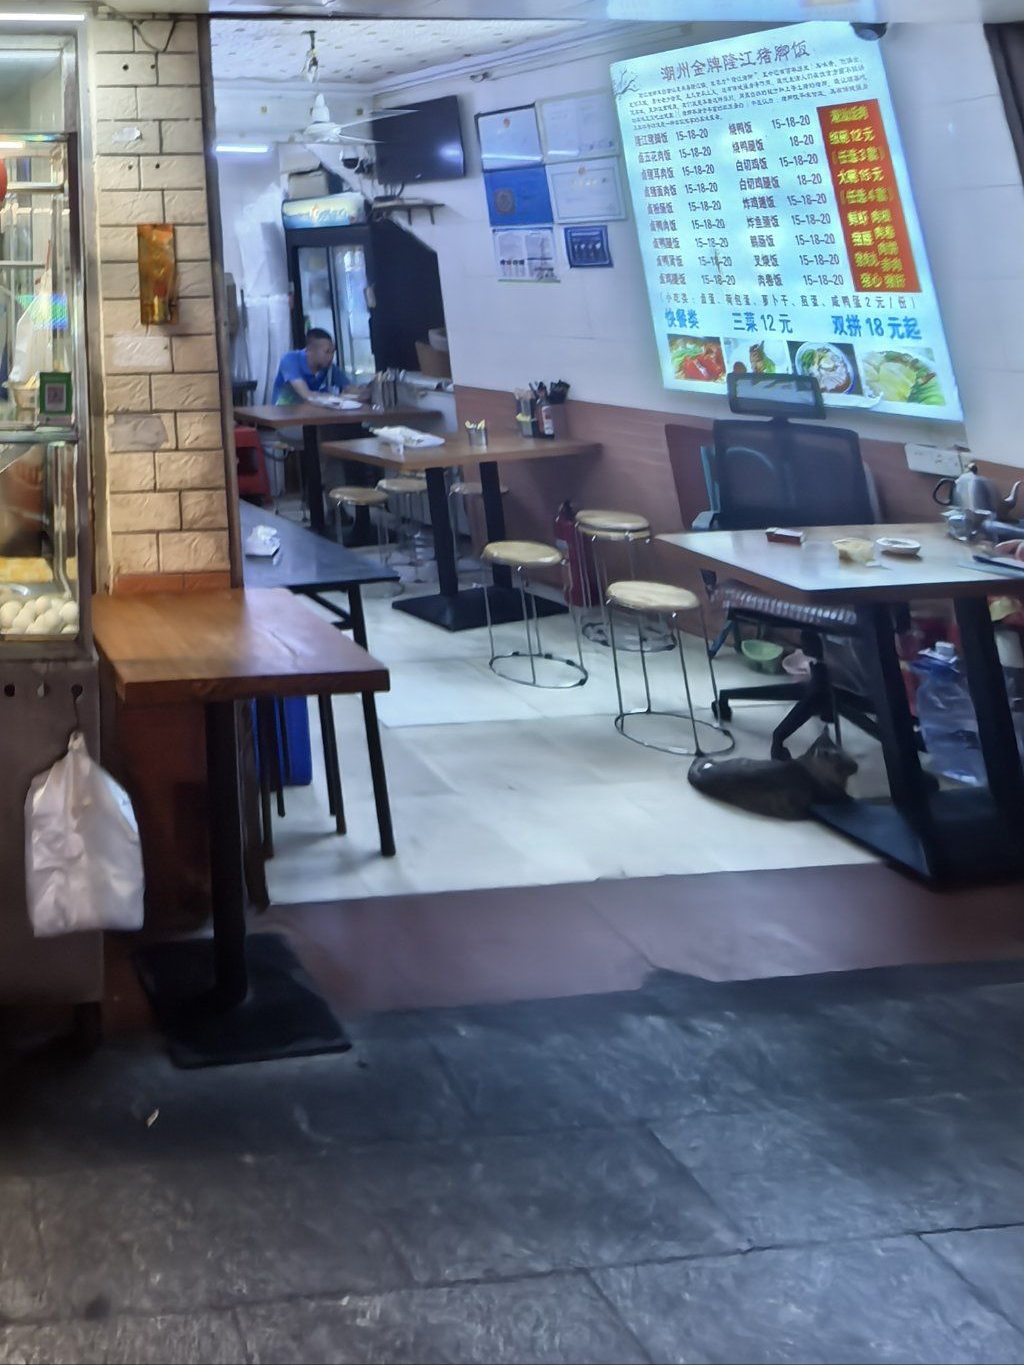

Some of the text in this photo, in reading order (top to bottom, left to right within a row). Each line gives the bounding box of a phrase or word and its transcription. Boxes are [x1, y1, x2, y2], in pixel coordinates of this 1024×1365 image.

[660, 39, 810, 81] 潮州金牌隆江猪脚饭
[771, 114, 810, 129] 15-18-20
[676, 128, 708, 141] 15-18-20
[789, 134, 814, 147] 18-20
[679, 146, 711, 158] 15-18-20
[779, 153, 818, 167] 15-18-20
[682, 164, 714, 176] 15-18-20
[797, 173, 822, 185] 18-20
[685, 182, 718, 193] 15-18-20
[688, 200, 721, 211] 15-18-20
[787, 193, 827, 206] 15-18-20
[691, 219, 725, 230] 15-18-20
[791, 213, 831, 225] 15-18-20
[695, 237, 728, 248] 15-18-20
[795, 233, 835, 246] 15-18-20
[799, 253, 840, 266] 15-18-20
[701, 274, 735, 285] 15-18-20
[802, 274, 844, 286] 15-18-20
[664, 308, 922, 339] 快餐类 三菜12元 双拼18元起
